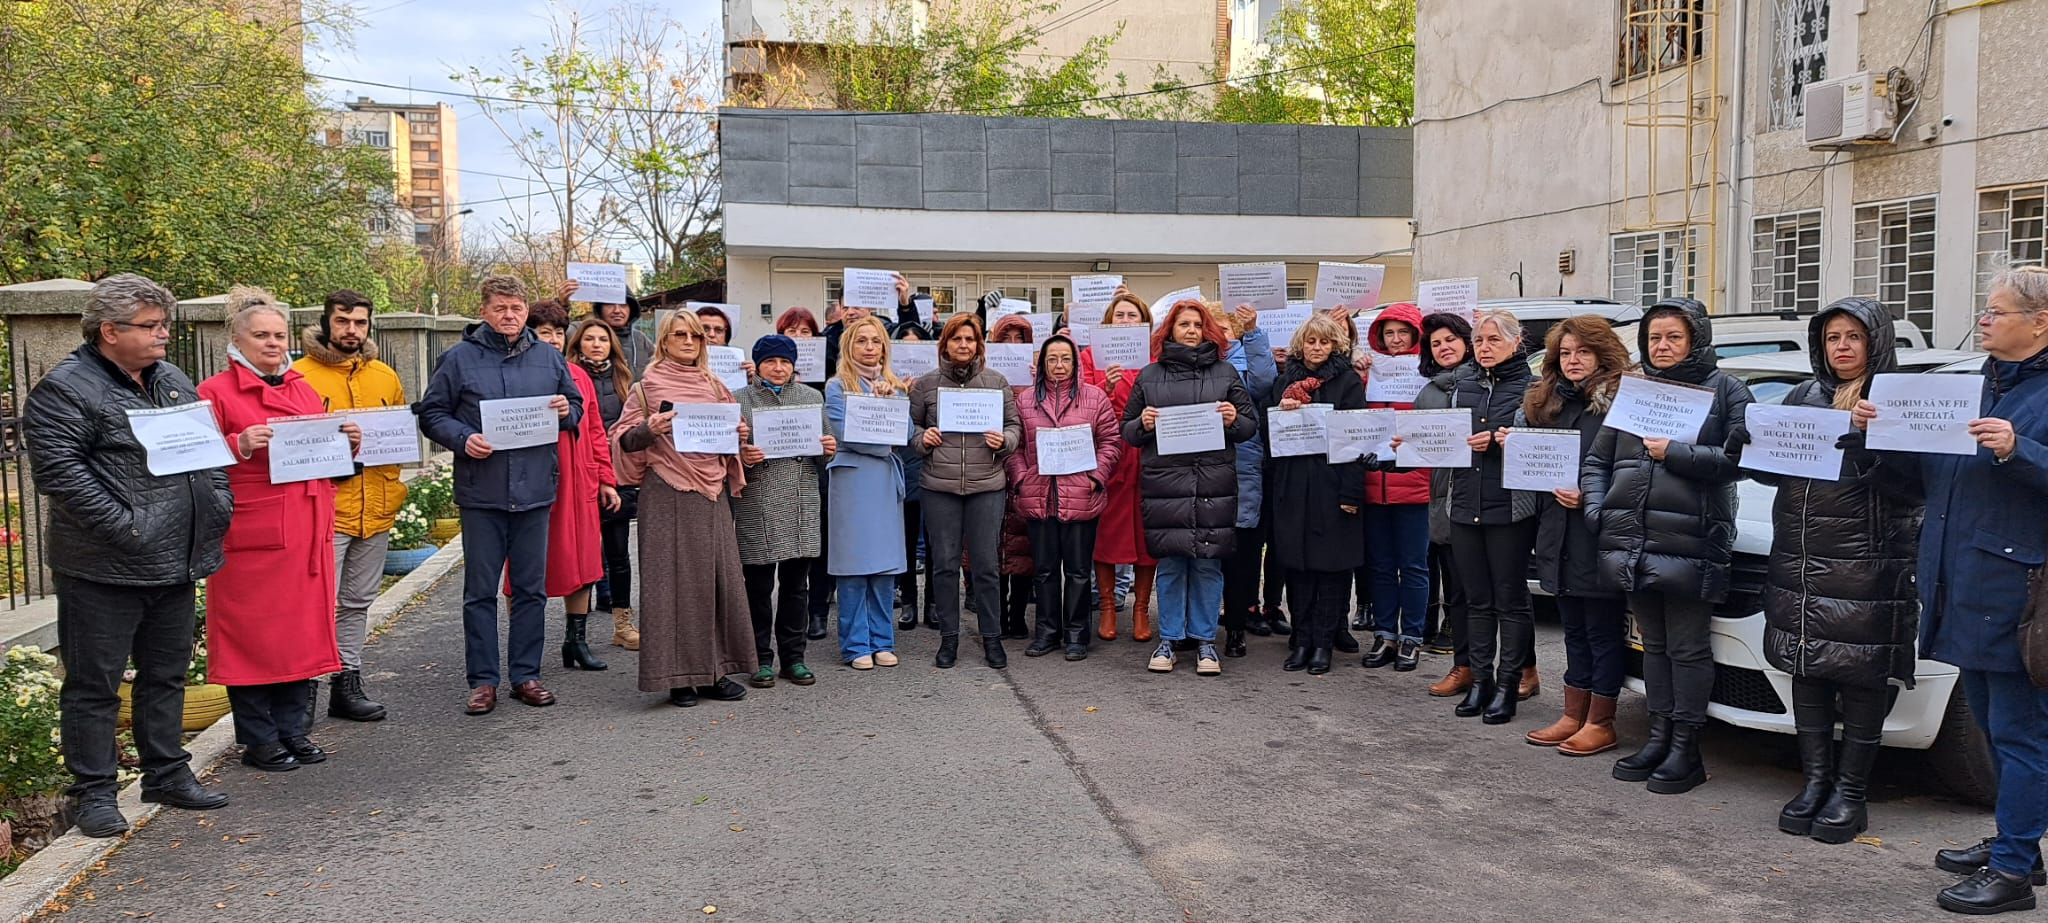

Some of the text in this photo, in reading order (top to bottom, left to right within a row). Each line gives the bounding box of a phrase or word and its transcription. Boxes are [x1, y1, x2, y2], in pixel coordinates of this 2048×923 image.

[1655, 393, 1677, 404] FĂRĂ
[1887, 399, 1921, 408] DORIM
[1922, 398, 1935, 407] SĂ
[1953, 400, 1969, 408] FIE
[1634, 399, 1694, 415] DISCRIMINĂRI
[1648, 408, 1673, 419] ÎNTRE
[1900, 410, 1955, 420] APRECIATĂ
[1629, 414, 1674, 428] CATEGORII
[1777, 420, 1816, 431] NU TOȚI
[1909, 423, 1947, 431] MUNCA!
[363, 430, 377, 439] NCĂ
[1763, 430, 1814, 441] BUGETARII
[284, 435, 336, 447] MUNCĂ EGALĂ
[1777, 440, 1815, 451] SALARII
[282, 456, 310, 467] SALARII
